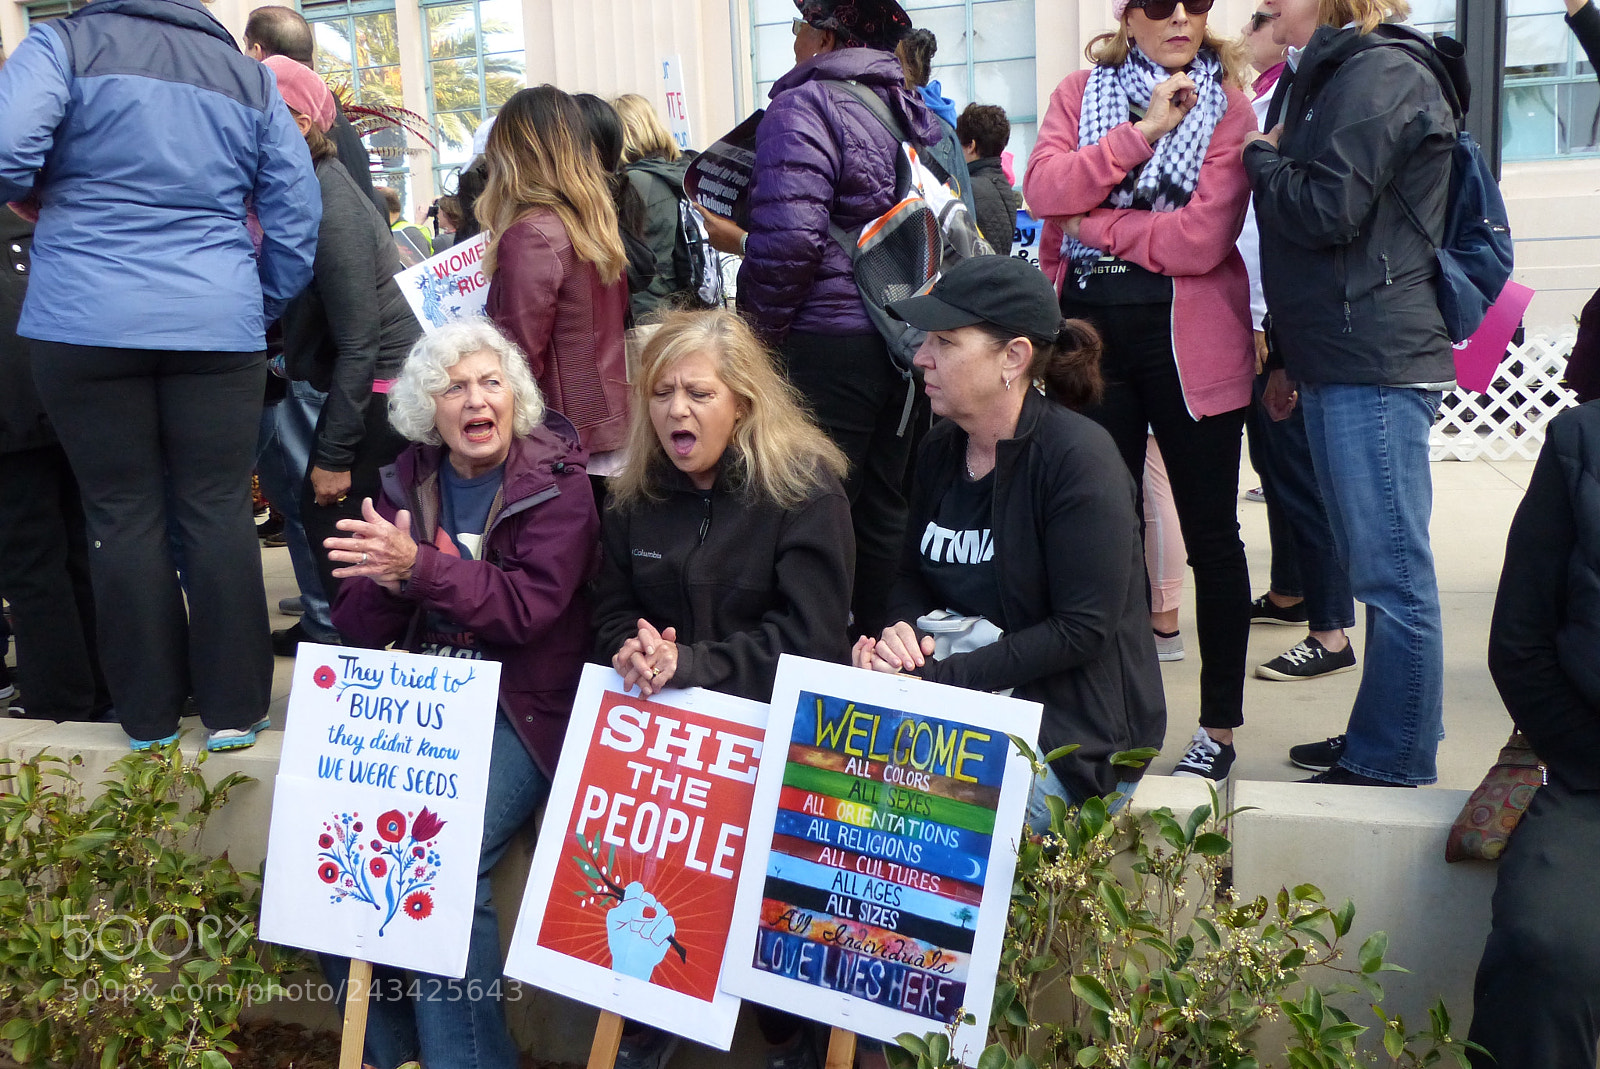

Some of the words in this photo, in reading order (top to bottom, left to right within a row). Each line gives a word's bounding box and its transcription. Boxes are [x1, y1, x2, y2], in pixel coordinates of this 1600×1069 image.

[698, 175, 739, 201] Immigrants
[702, 193, 733, 217] Refugees
[433, 241, 489, 280] WOME
[633, 548, 662, 560] Columbia
[338, 654, 384, 690] They
[390, 662, 438, 690] tried
[443, 668, 467, 692] to
[350, 693, 409, 724] BURY
[417, 701, 445, 730] US
[328, 724, 365, 755] they
[369, 729, 414, 754] didn't
[416, 738, 460, 760] know
[600, 705, 763, 785] SHE
[816, 699, 991, 783] WELCOME
[318, 755, 345, 781] WE
[349, 760, 399, 788] WERE
[403, 767, 459, 799] SEEDS.
[627, 760, 712, 808] THE
[845, 756, 871, 778] ALL
[883, 765, 930, 791] COLORS
[848, 780, 878, 804] ALL
[887, 787, 932, 816] SEXES
[576, 785, 744, 879] PEOPLE
[803, 794, 825, 817] ALL
[836, 802, 960, 848] ORIENTATIONS
[807, 819, 831, 842] ALL
[837, 825, 923, 864] RELIGIONS
[818, 847, 847, 869] ALL
[856, 856, 941, 893] CULTURES
[831, 871, 858, 896] ALL
[862, 879, 902, 907] AGES
[825, 894, 854, 918] ALL
[858, 902, 900, 930] SIZES
[769, 909, 812, 934] All
[823, 925, 954, 974] Individuals
[754, 926, 816, 980] LOVE
[819, 943, 885, 1000] LIVES
[888, 969, 953, 1017] HERE
